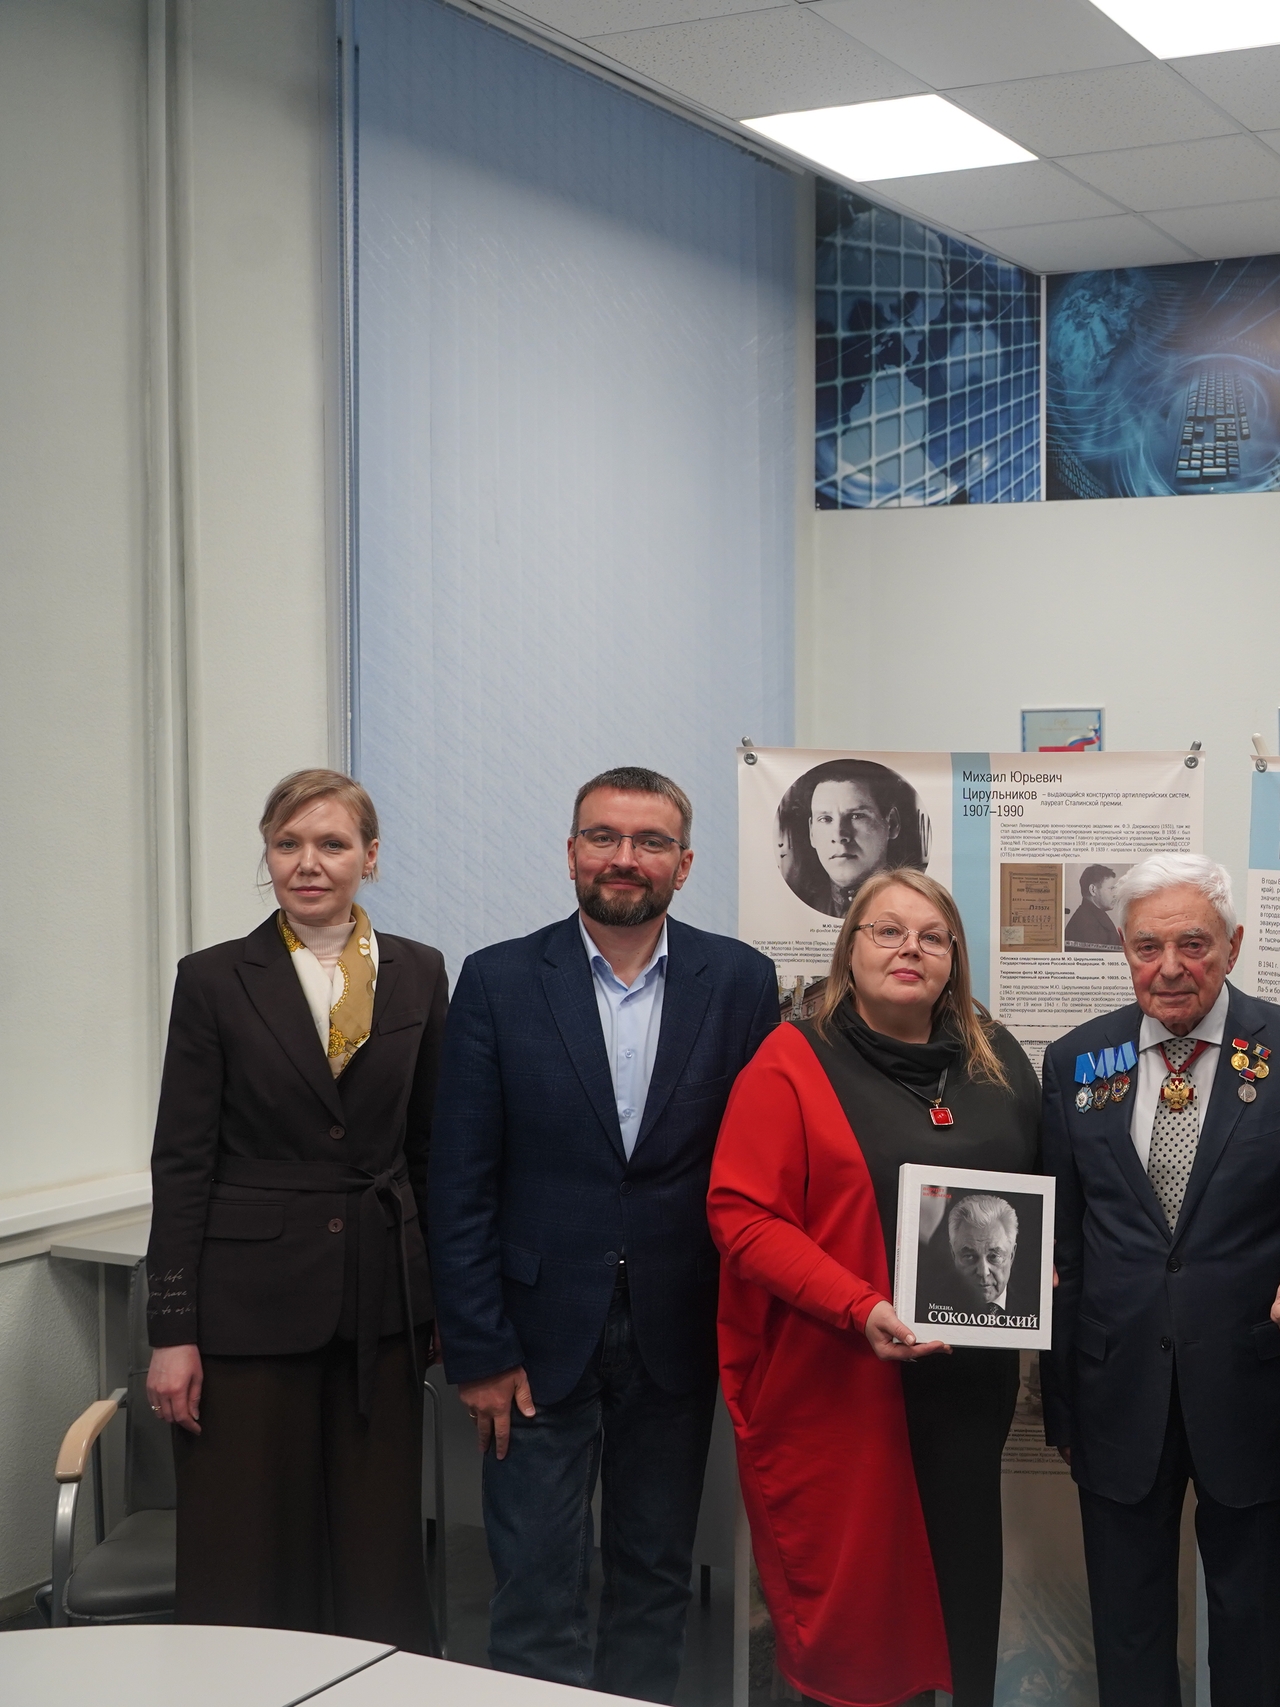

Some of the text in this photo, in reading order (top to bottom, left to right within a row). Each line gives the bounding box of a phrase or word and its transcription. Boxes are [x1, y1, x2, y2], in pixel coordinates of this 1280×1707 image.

[962, 771, 1063, 787] Михаил Юрьевич
[962, 787, 1038, 804] Цирульников
[1121, 791, 1168, 799] артиллерийских
[1040, 799, 1064, 807] лауреат
[1064, 799, 1099, 807] Сталинской
[962, 805, 1024, 818] 1907–1990
[928, 1302, 954, 1311] Михаил
[927, 1311, 1038, 1328] СОКОЛОВСКИЙ
